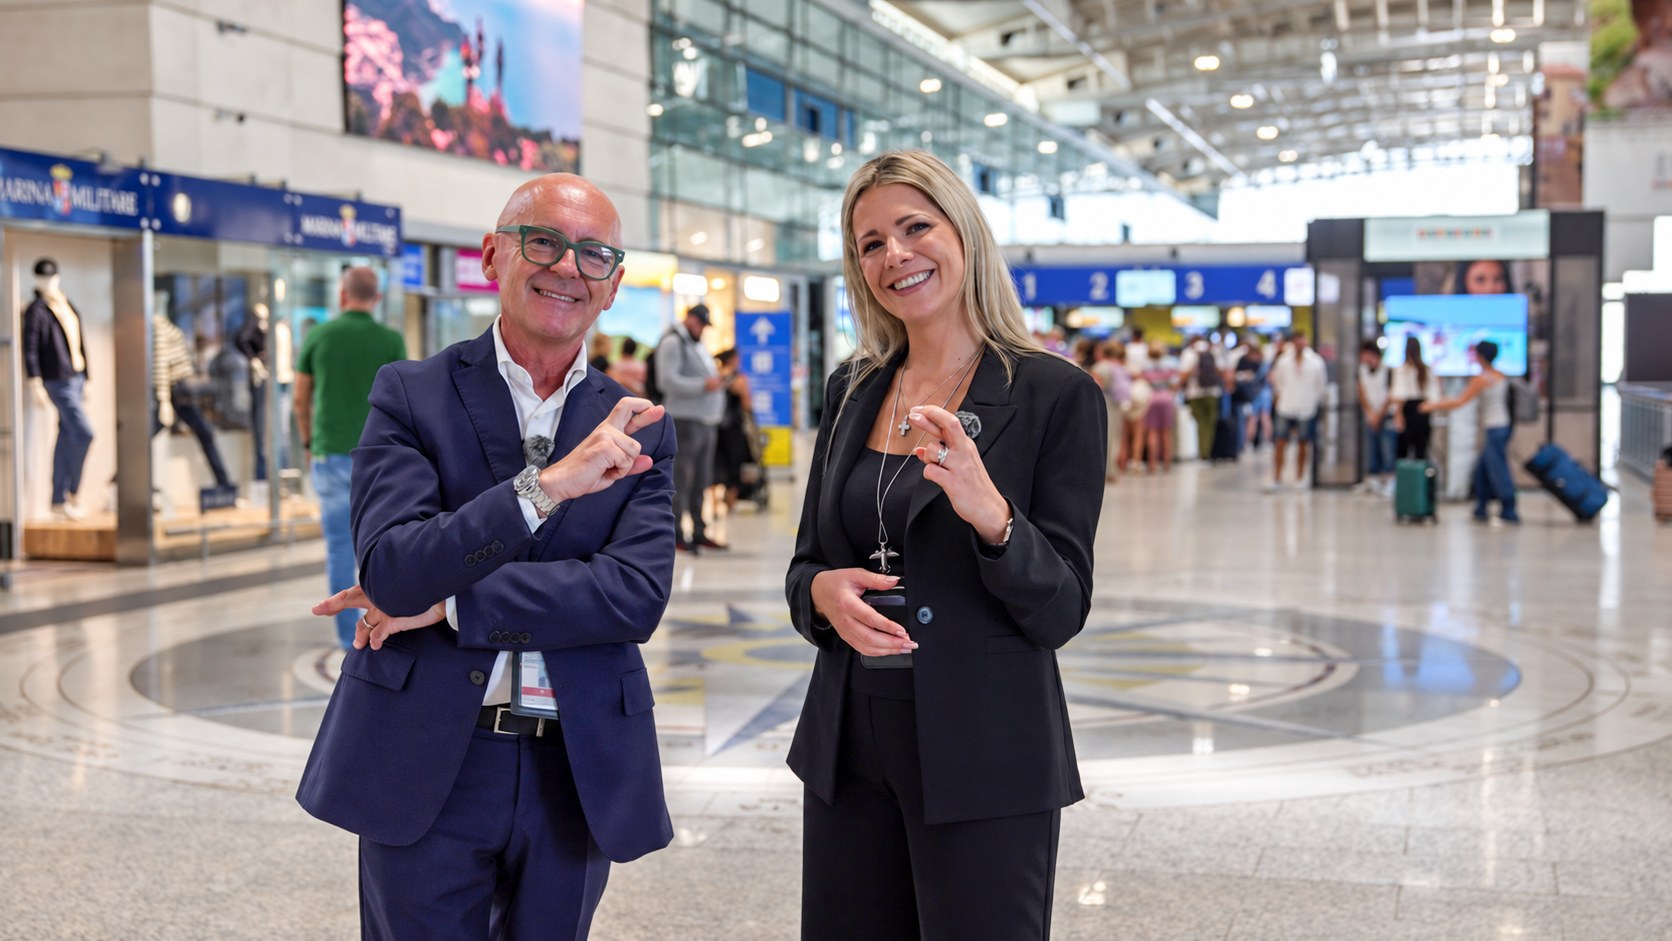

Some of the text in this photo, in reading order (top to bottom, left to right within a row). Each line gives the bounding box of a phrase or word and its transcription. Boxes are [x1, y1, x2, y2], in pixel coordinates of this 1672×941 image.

[71, 184, 138, 216] MILITARE
[1023, 270, 1277, 300] 1 2 3 4
